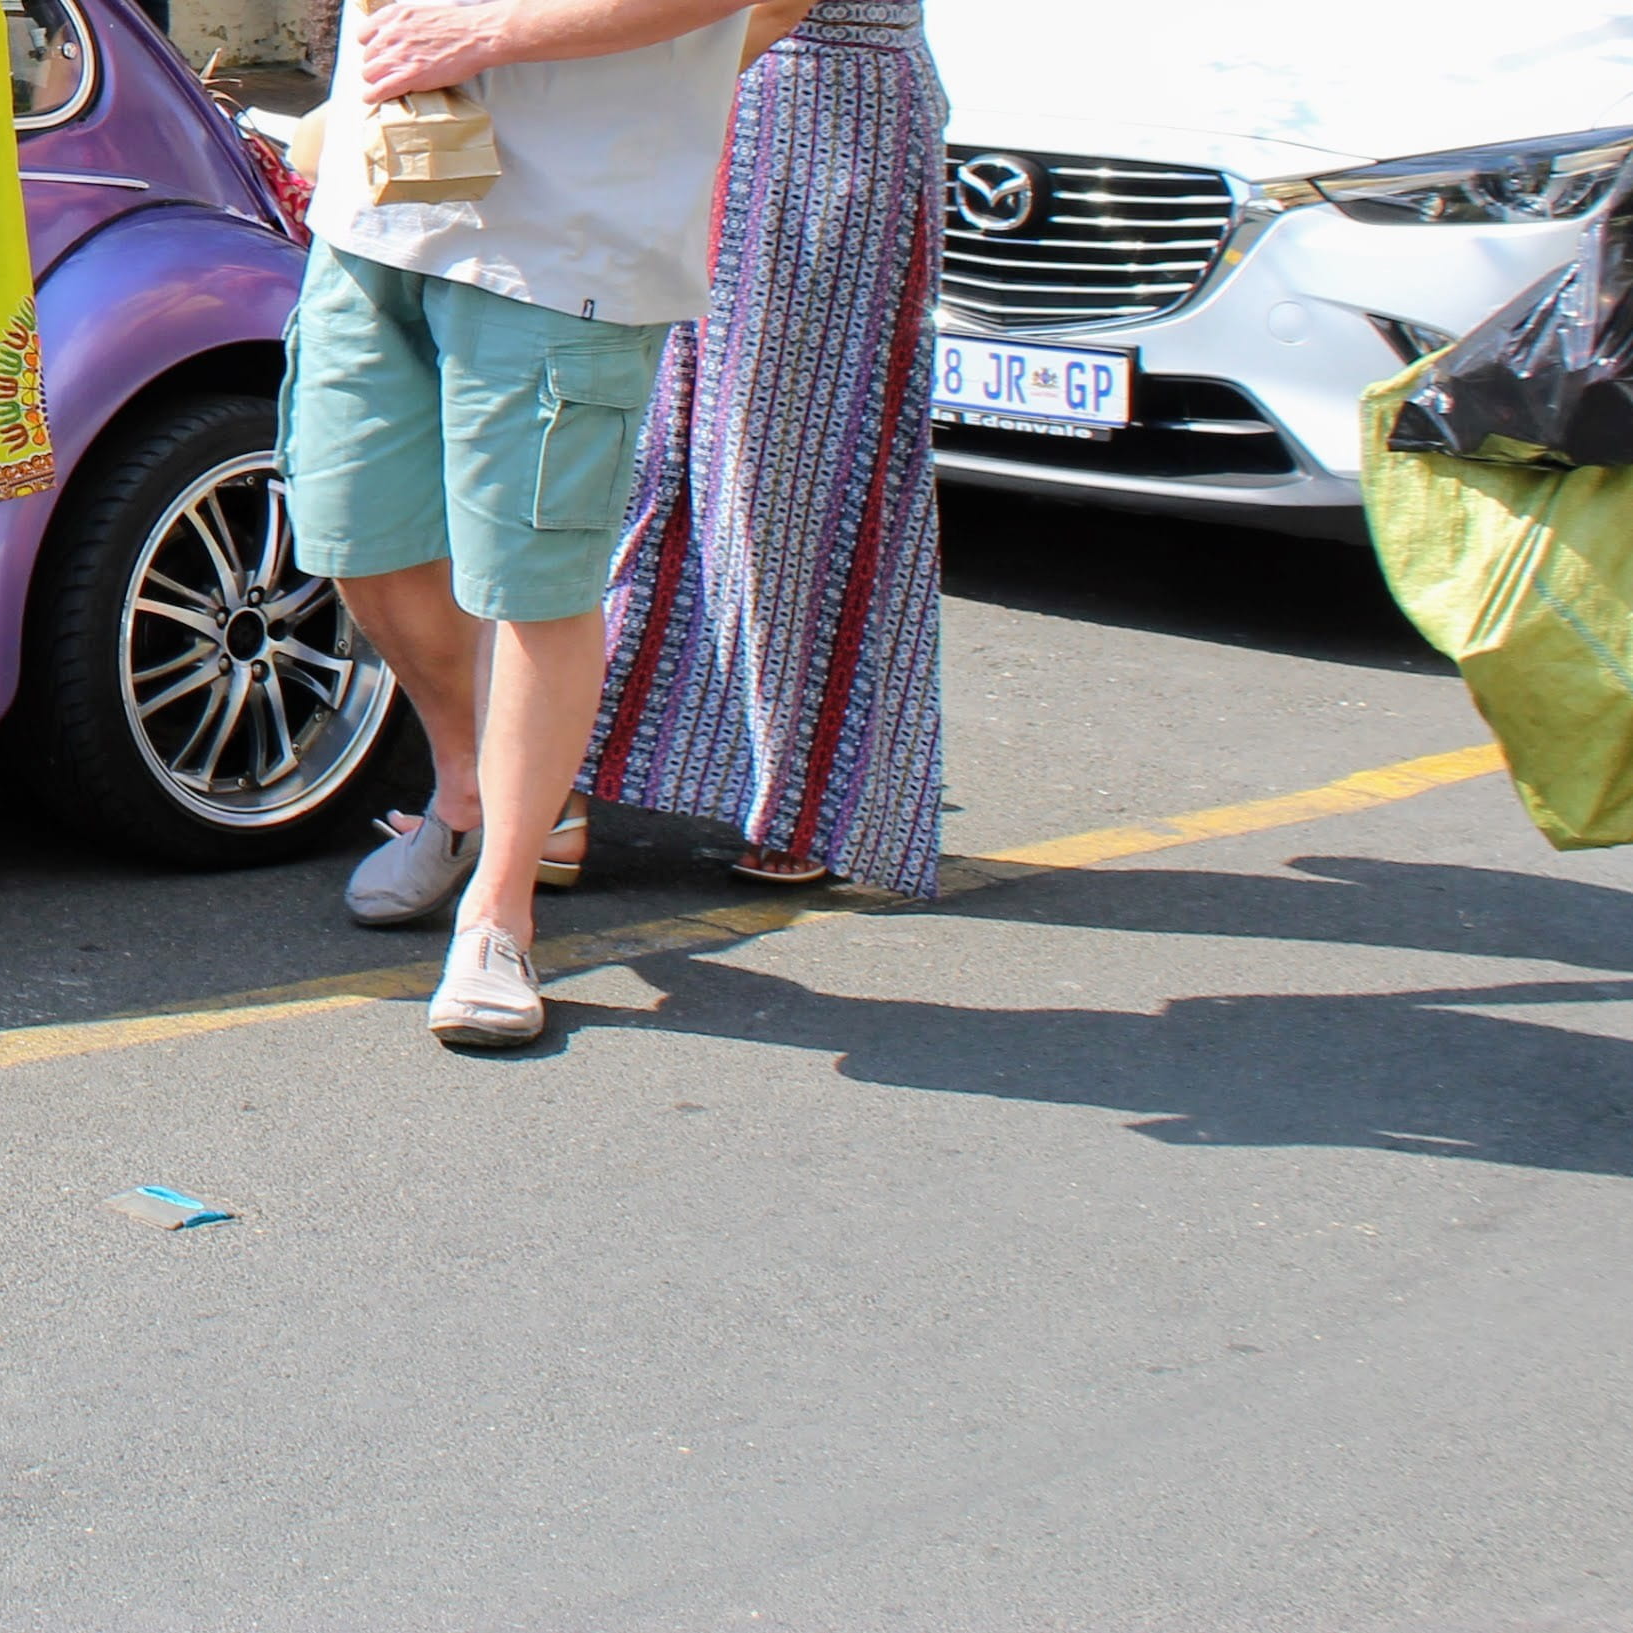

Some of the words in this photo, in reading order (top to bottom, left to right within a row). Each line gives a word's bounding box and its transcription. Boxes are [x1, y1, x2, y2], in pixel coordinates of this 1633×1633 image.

[983, 352, 1027, 404] JR
[1065, 361, 1113, 412] GP
[964, 412, 1094, 439] Edenvale
